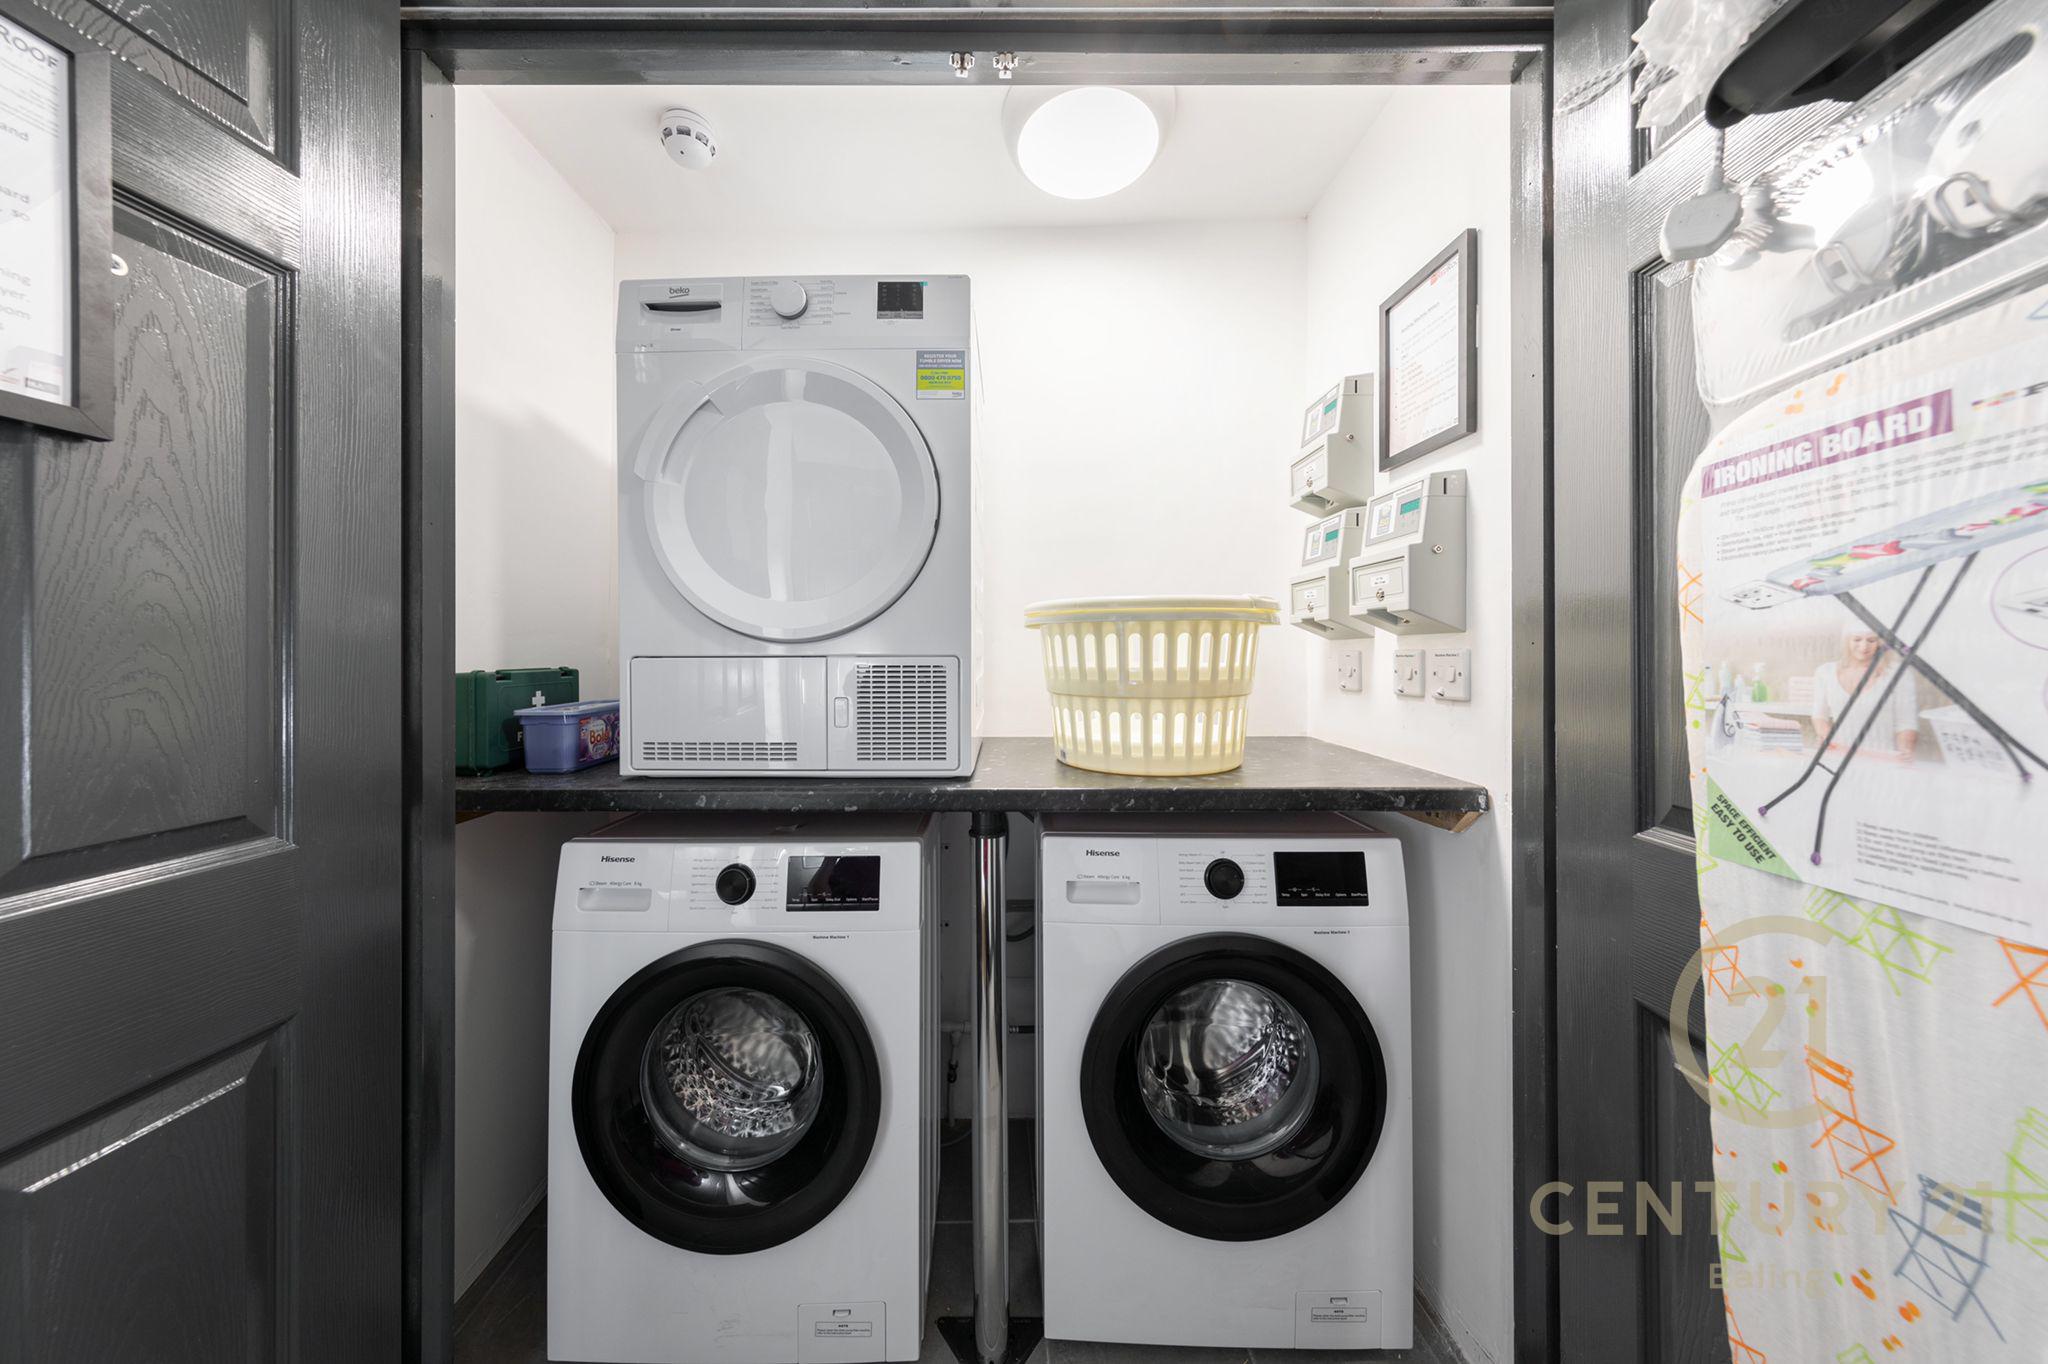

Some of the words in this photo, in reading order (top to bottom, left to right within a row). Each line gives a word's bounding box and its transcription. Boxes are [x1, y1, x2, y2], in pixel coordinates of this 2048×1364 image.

[669, 286, 690, 296] beko
[1713, 441, 1813, 489] IRONING
[1821, 405, 1933, 459] BOARD
[1086, 849, 1120, 857] Hisense
[1711, 803, 1735, 828] EASY
[1733, 828, 1747, 842] TO
[1744, 842, 1766, 864] USE
[1716, 794, 1741, 820] SPACE
[1739, 819, 1776, 859] EFFICIENT
